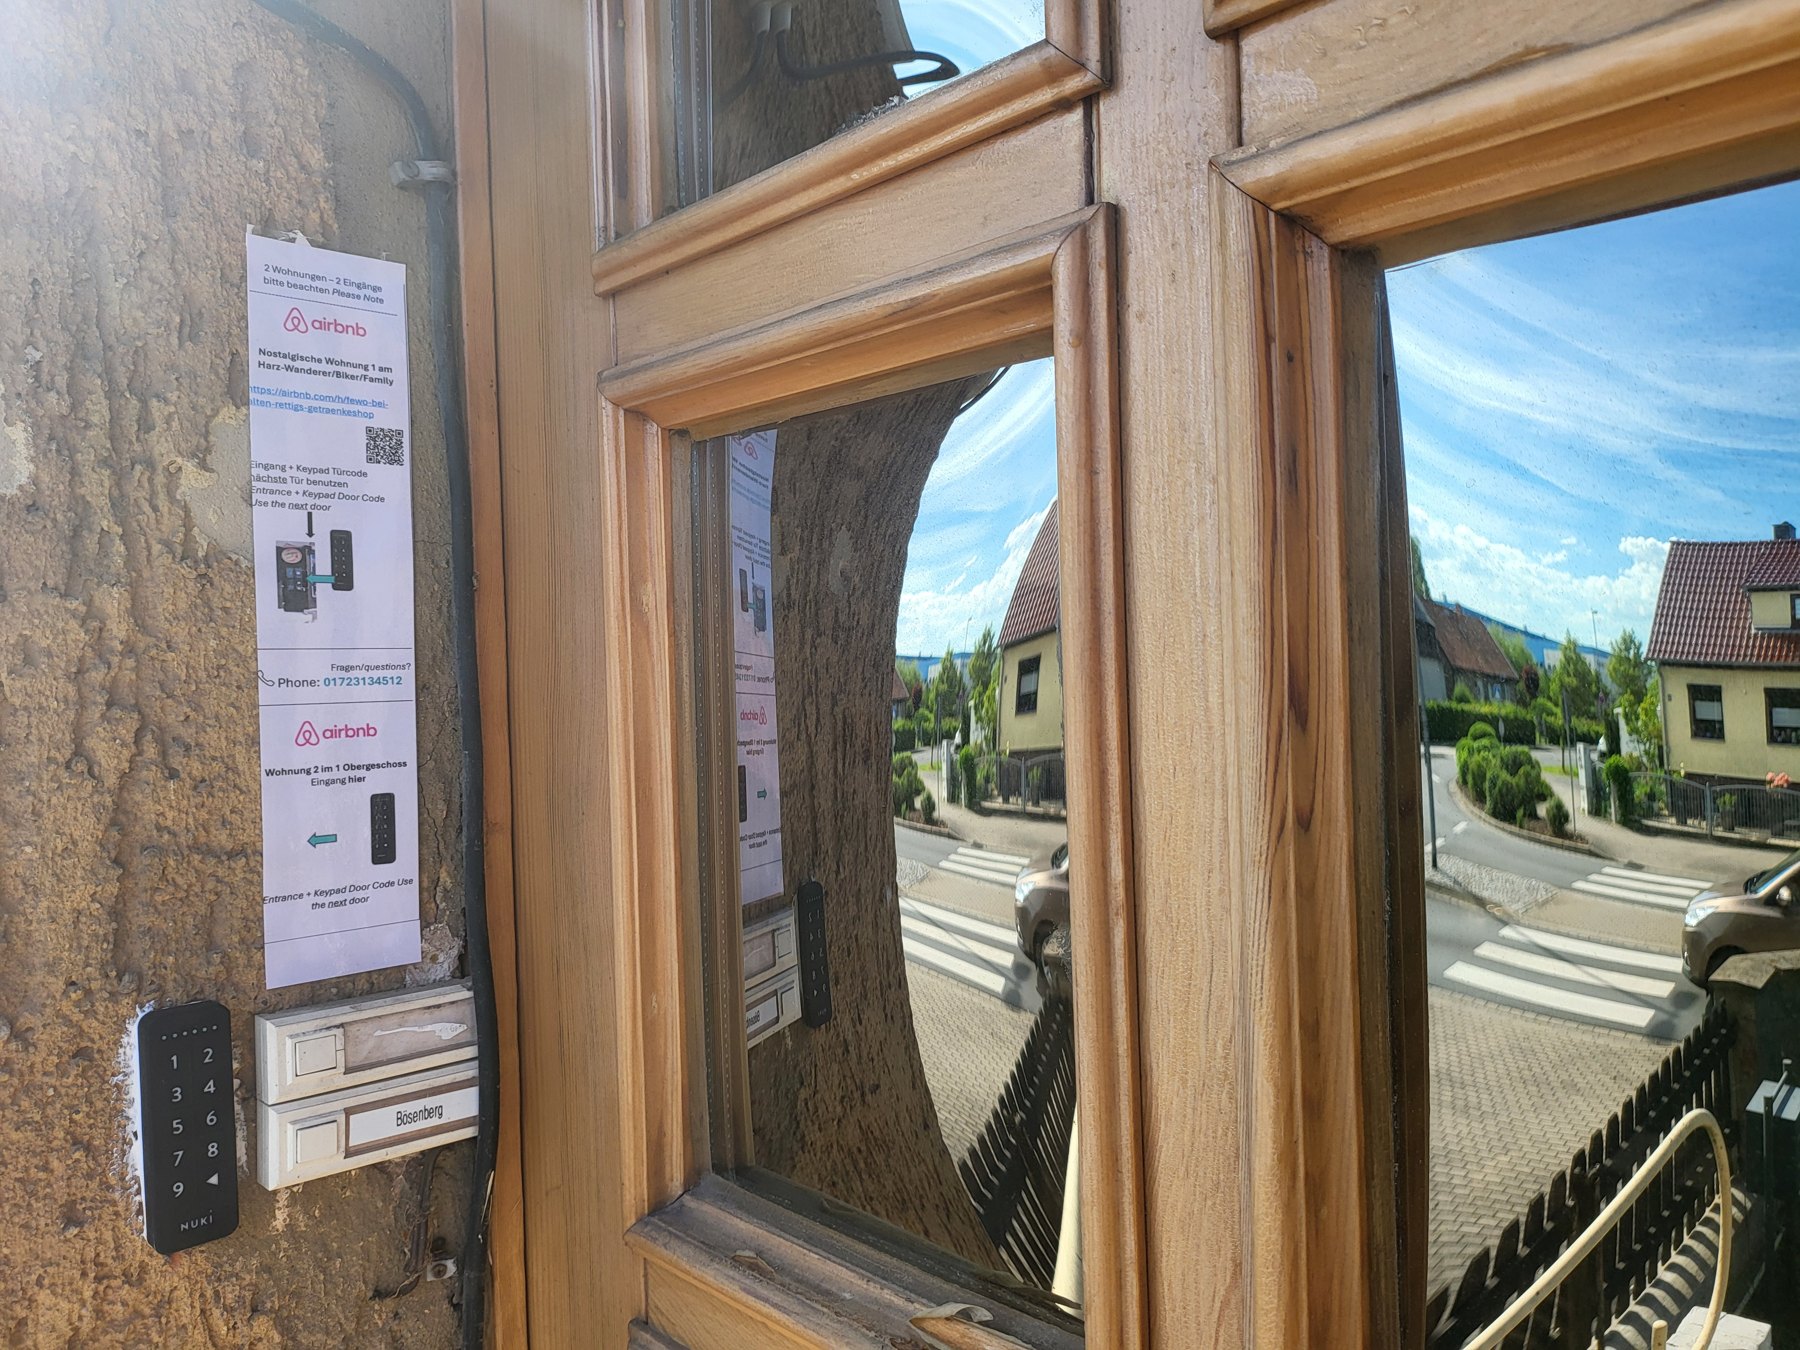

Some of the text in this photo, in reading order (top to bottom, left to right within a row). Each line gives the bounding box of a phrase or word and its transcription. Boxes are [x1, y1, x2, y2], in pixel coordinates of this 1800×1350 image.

[264, 264, 270, 273] 2
[271, 265, 327, 282] Wohnungen
[335, 277, 342, 286] 2
[343, 279, 383, 293] Eingänge
[263, 276, 385, 304] bitte beachten Please Note
[311, 317, 367, 337] airbnb
[258, 347, 323, 364] Nostalgische
[324, 356, 370, 372] Wohnung
[378, 365, 393, 374] am
[257, 360, 394, 387] Harz-Wanderer/Biker/Family
[251, 460, 287, 473] Eingang
[296, 464, 330, 477] Keypad
[331, 467, 368, 478] Türcode
[289, 475, 304, 485] Tür
[306, 478, 349, 489] benutzen
[251, 485, 292, 497] Entrance
[302, 488, 336, 501] Keypad
[337, 491, 360, 501] Door
[361, 493, 385, 503] Code
[271, 499, 286, 508] the
[288, 501, 308, 511] next
[310, 502, 331, 512] door
[330, 663, 411, 673] Fragen/questions?
[278, 676, 403, 688] Phone: 01723134512
[322, 723, 378, 740] airbnb
[265, 766, 312, 777] Wohnung
[313, 765, 319, 774] 2
[321, 763, 333, 773] im
[342, 760, 408, 772] Obergeschoss
[311, 775, 366, 787] Eingang hier
[262, 893, 304, 905] Entrance
[313, 885, 347, 898] Keypad
[348, 883, 371, 893] Door
[372, 879, 396, 890] Code
[397, 877, 414, 886] Use
[311, 895, 370, 910] the next door
[170, 1047, 214, 1070] 1 2
[171, 1079, 216, 1102] 3 4
[172, 1110, 217, 1134] 5 6
[396, 1104, 443, 1127] Bösenberg
[173, 1142, 218, 1167] 7 8
[172, 1181, 184, 1198] 9
